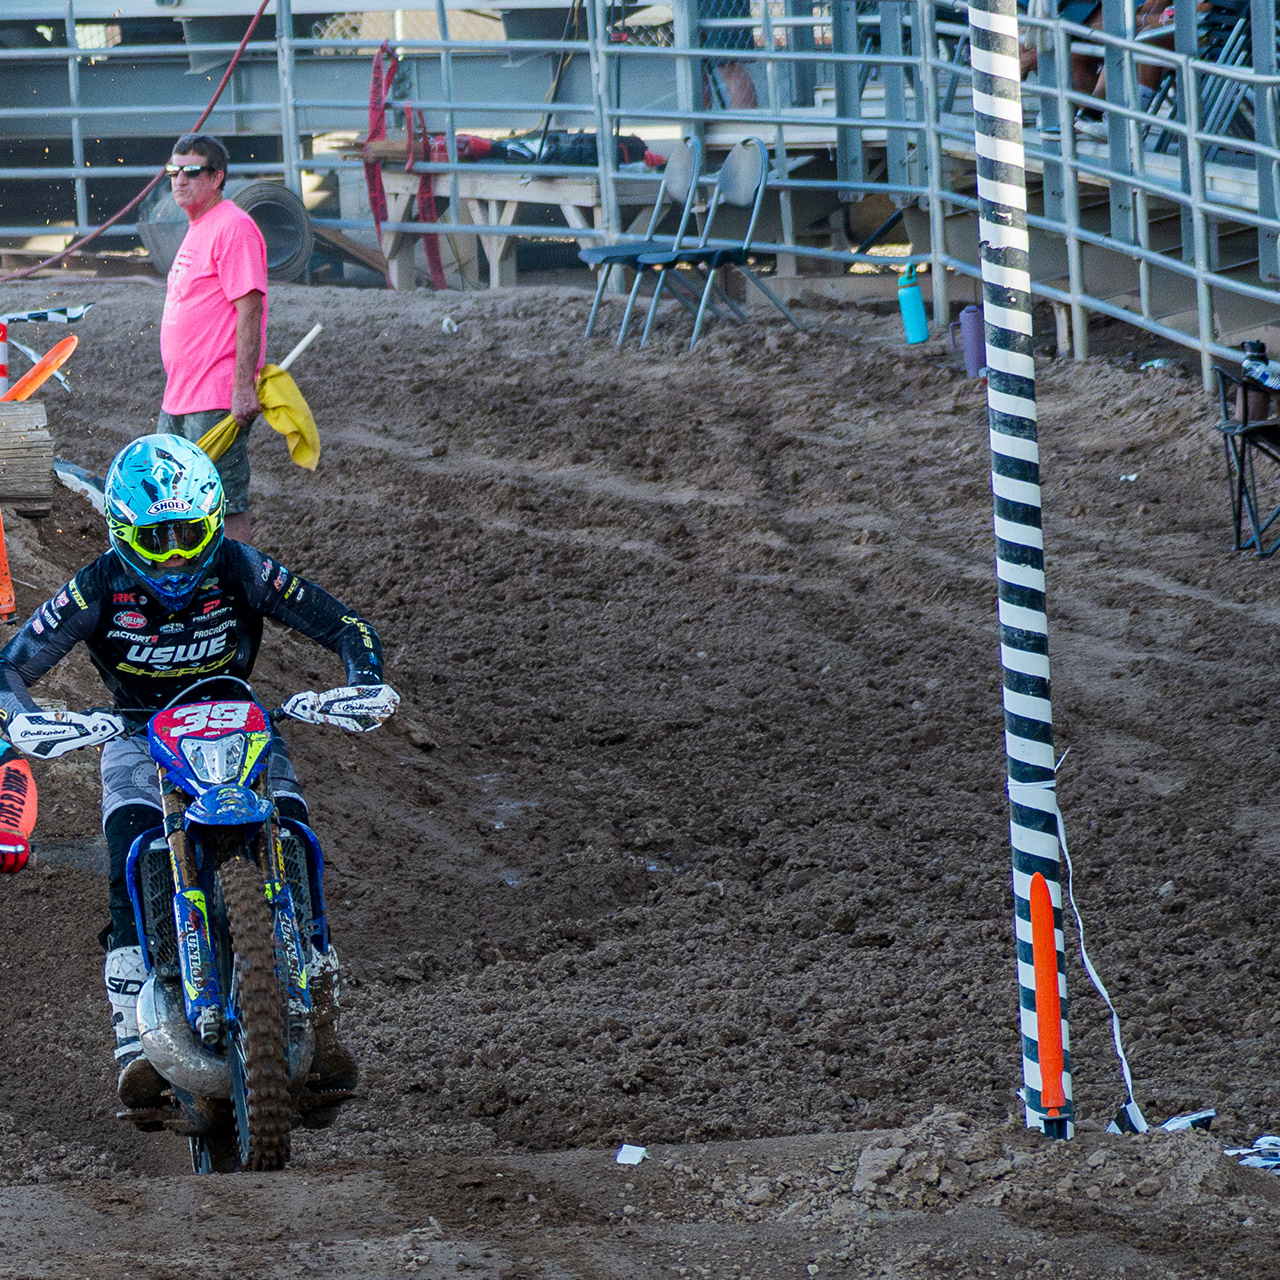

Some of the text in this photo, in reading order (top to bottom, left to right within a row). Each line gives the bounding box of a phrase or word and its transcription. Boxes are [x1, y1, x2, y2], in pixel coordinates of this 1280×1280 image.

[153, 501, 185, 513] SHOEI
[113, 593, 136, 603] RK
[107, 630, 152, 643] FACTORY
[126, 633, 227, 664] USWE
[116, 648, 237, 678] SHERCO
[343, 703, 388, 712] Polisport
[170, 702, 251, 737] 39
[20, 729, 66, 738] Polisport
[185, 921, 204, 992] DUNLOP
